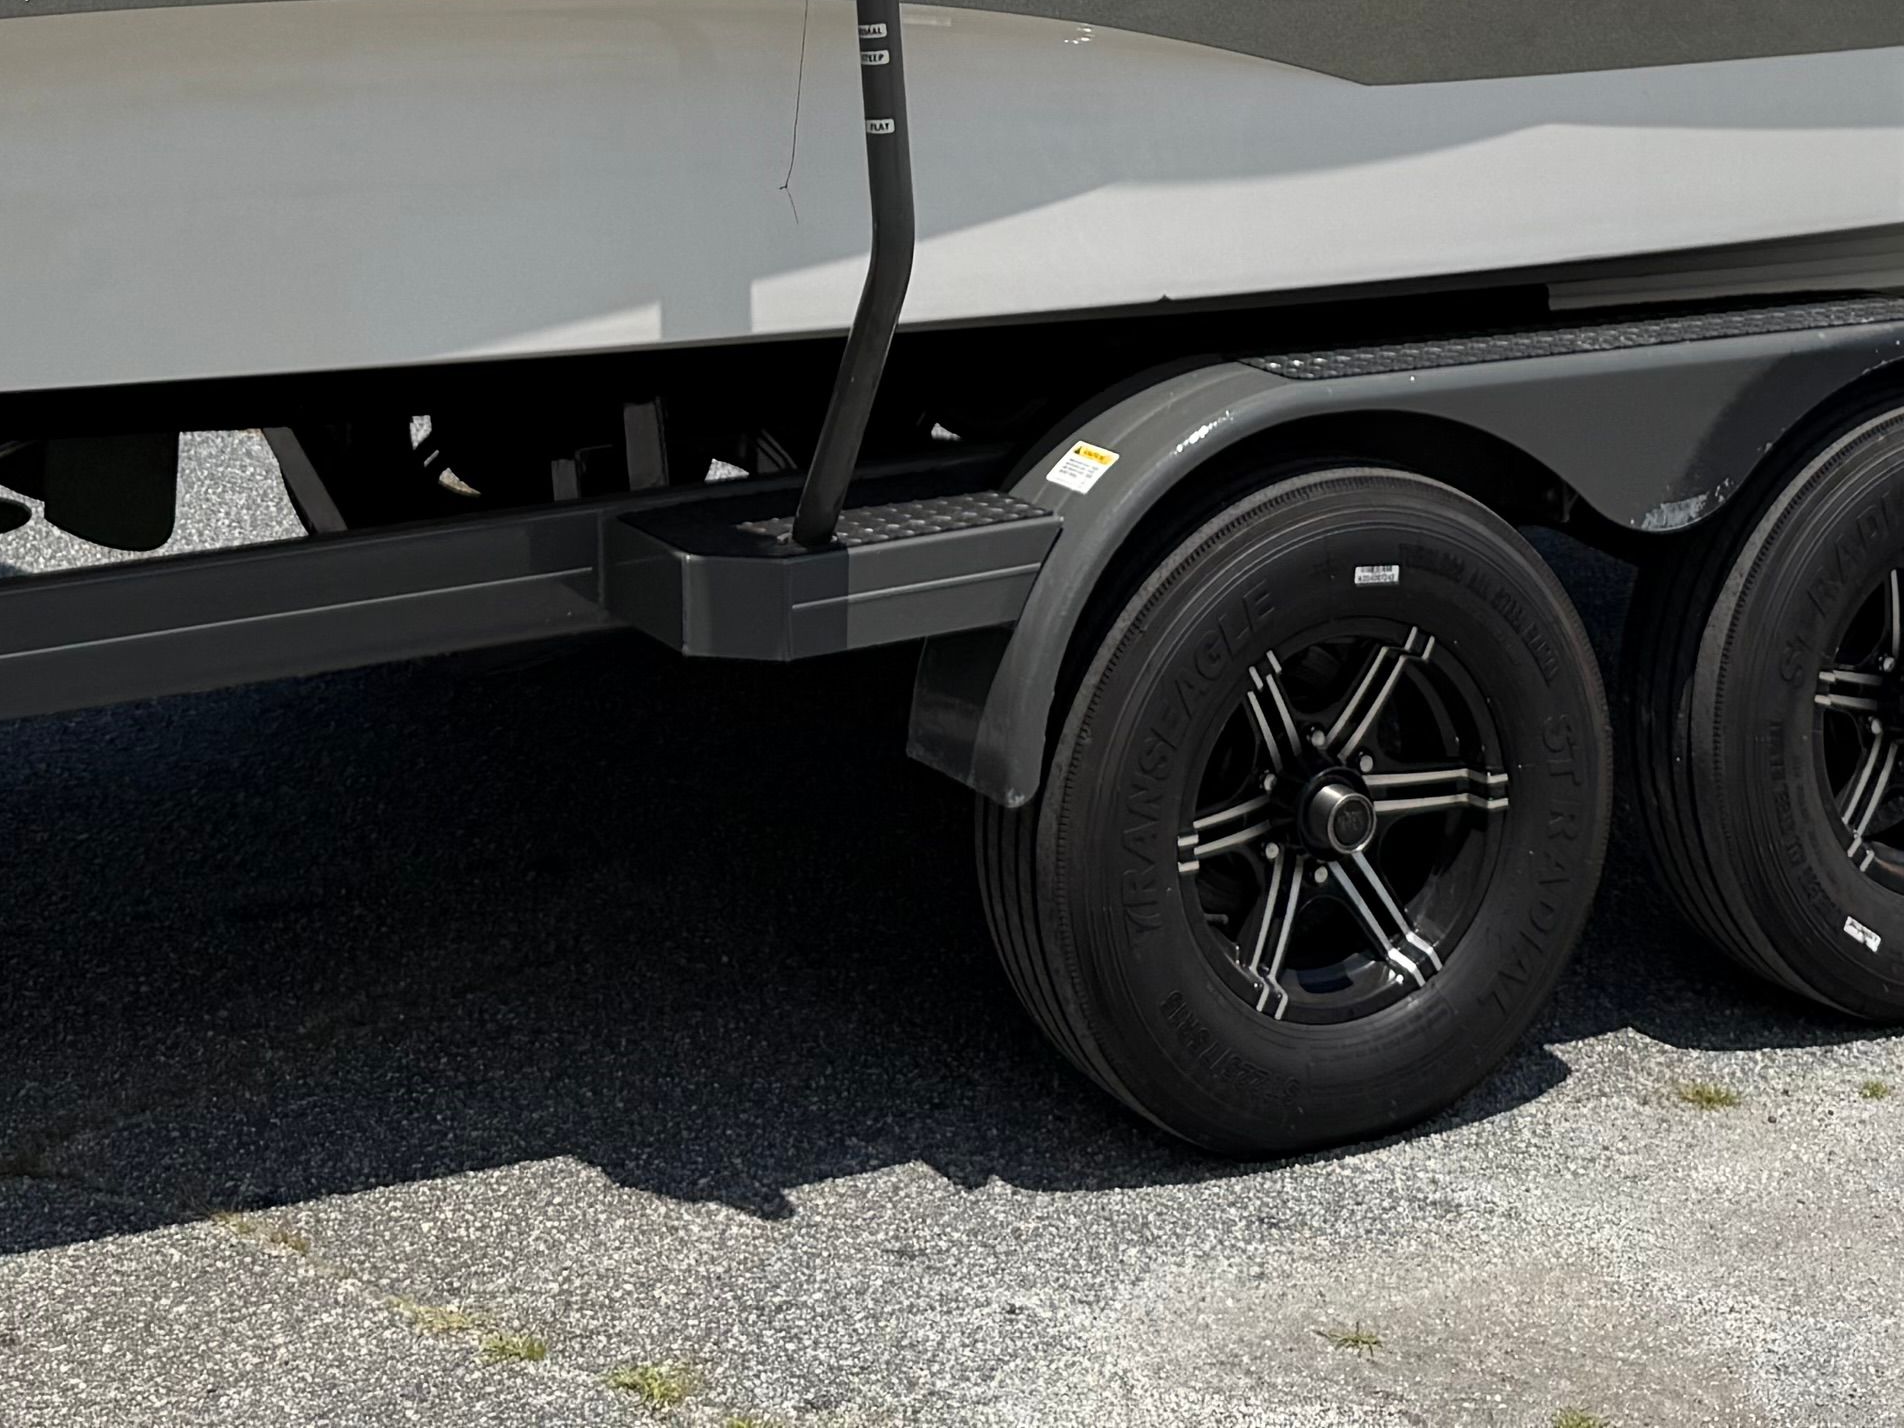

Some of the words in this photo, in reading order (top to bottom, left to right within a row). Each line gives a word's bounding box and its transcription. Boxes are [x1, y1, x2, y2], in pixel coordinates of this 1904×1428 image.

[1121, 577, 1276, 948] TRANSEAGLE
[1540, 710, 1586, 794] ST
[1482, 804, 1587, 1017] RADIAL
